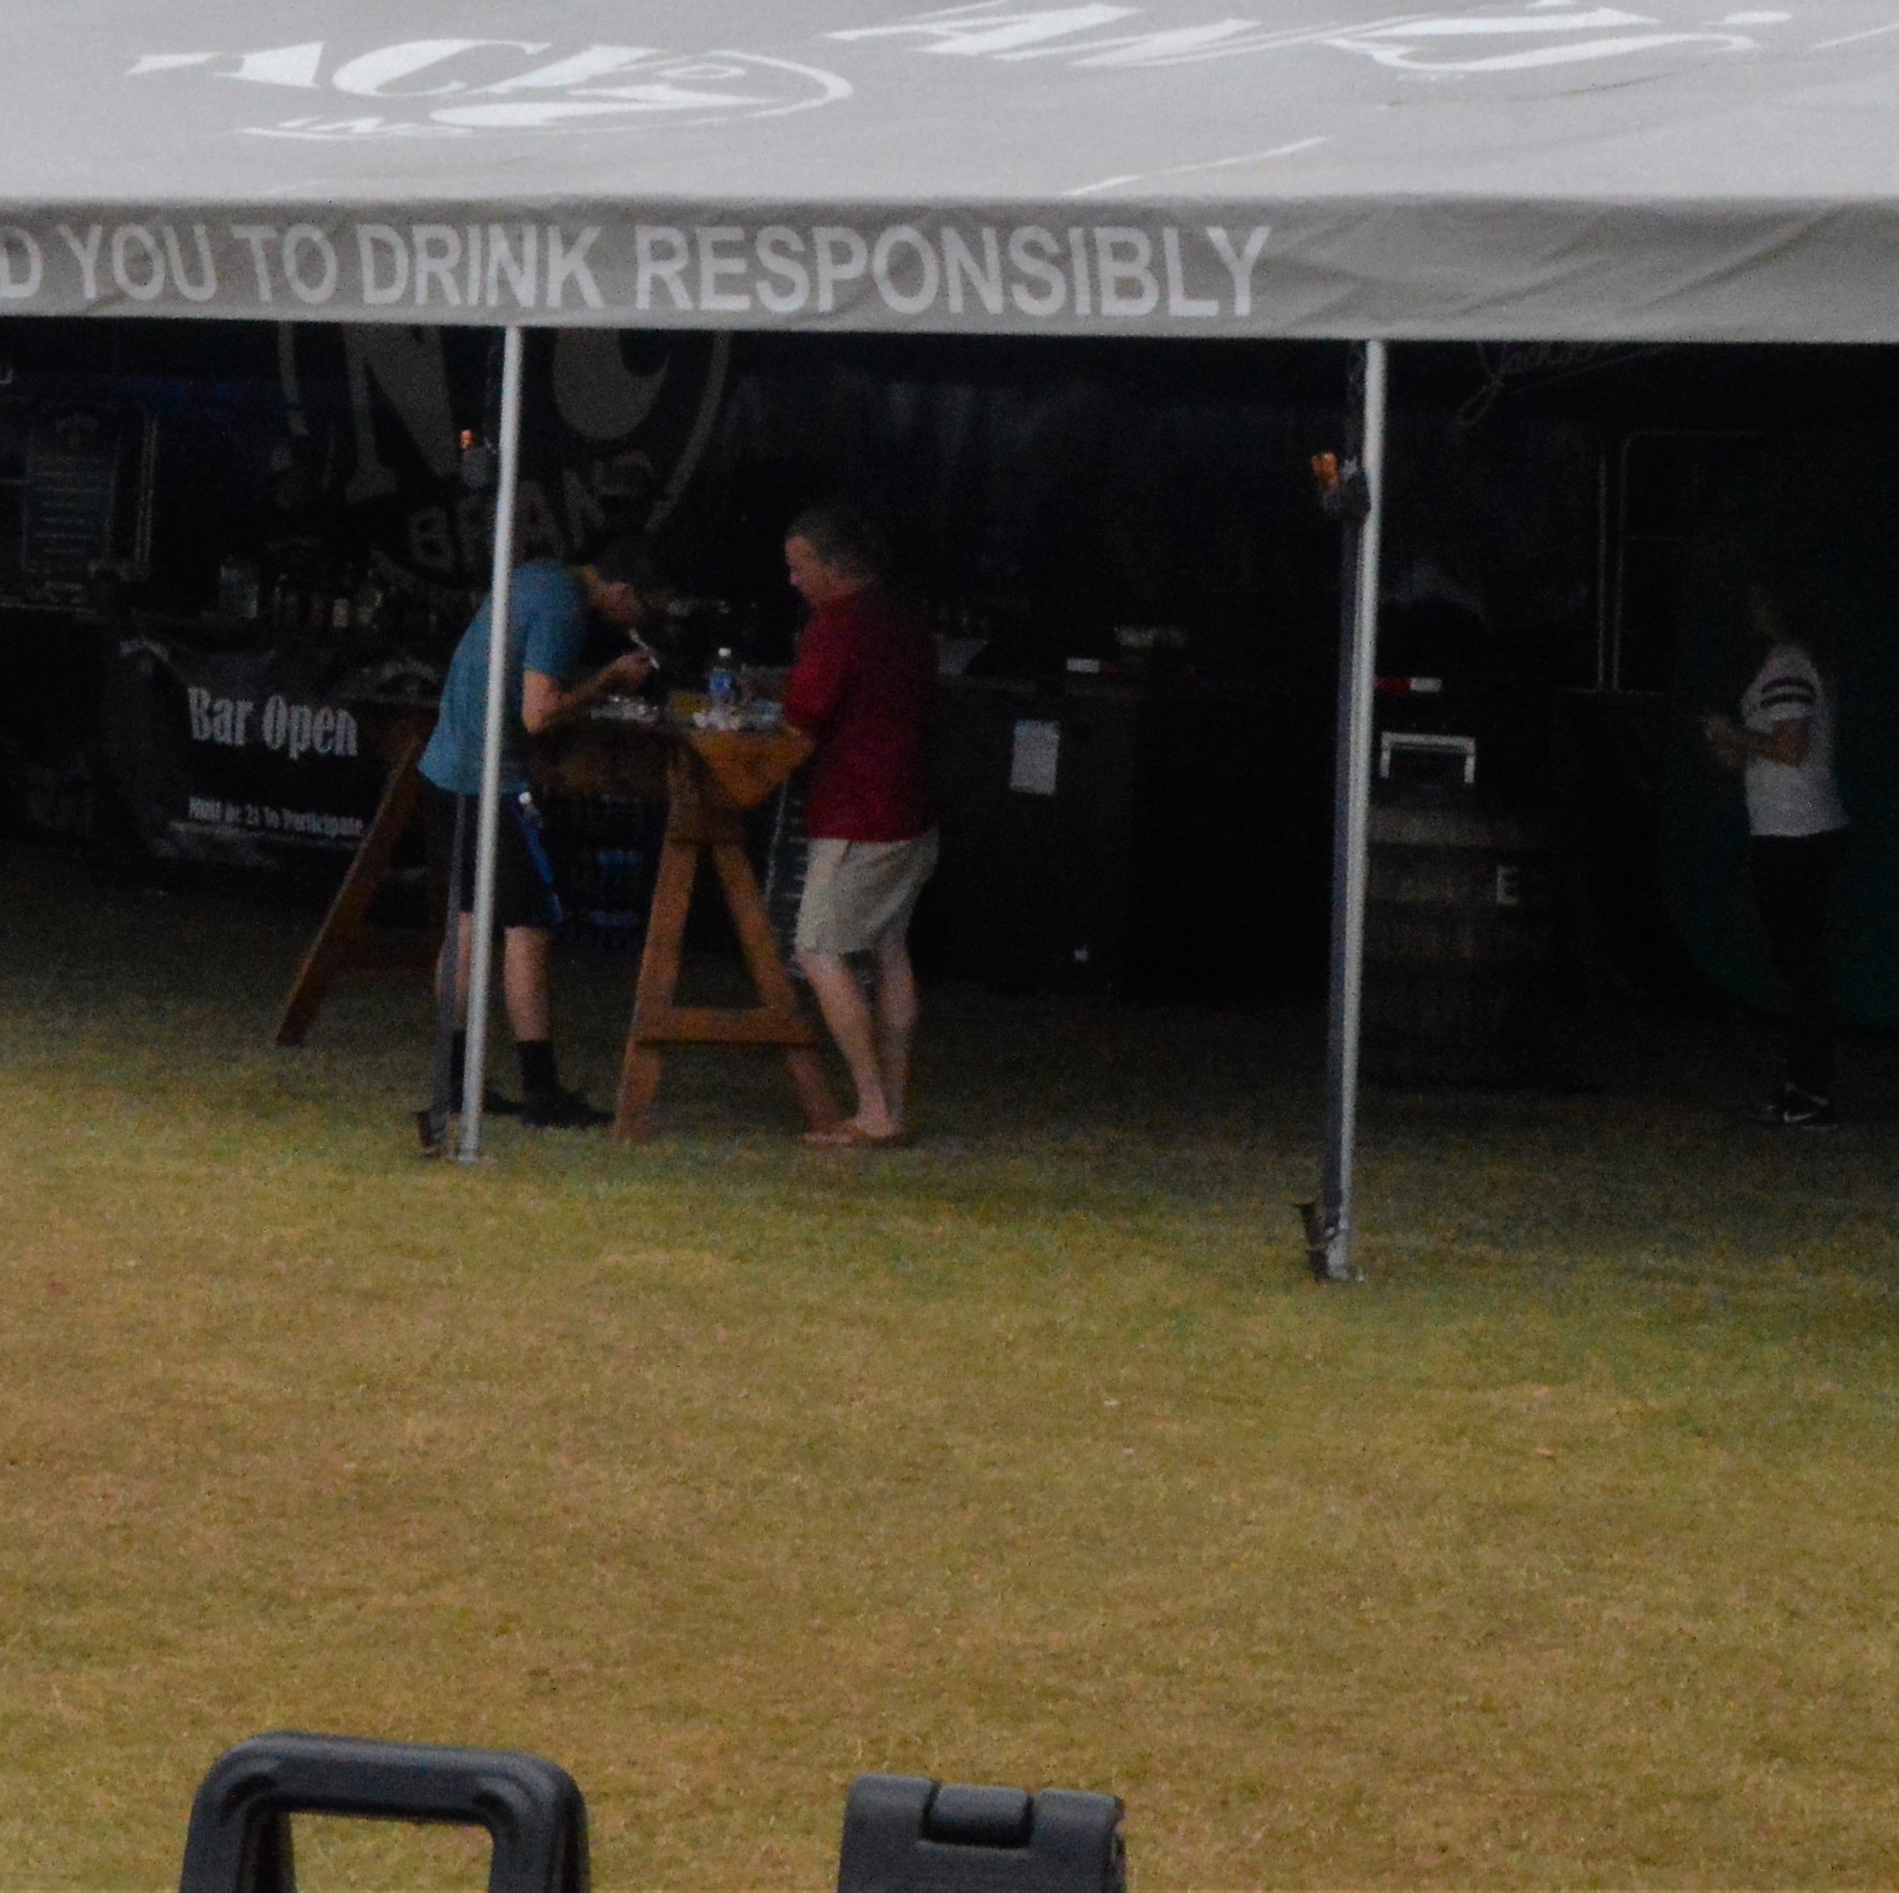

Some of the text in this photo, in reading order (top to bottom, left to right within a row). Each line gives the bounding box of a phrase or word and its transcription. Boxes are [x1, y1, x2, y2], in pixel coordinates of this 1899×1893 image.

[57, 223, 220, 302] YOU
[232, 223, 339, 304] TO
[357, 223, 604, 310] DRINK
[633, 225, 1273, 318] RESPONSIBLY
[188, 686, 359, 761] Bar Open
